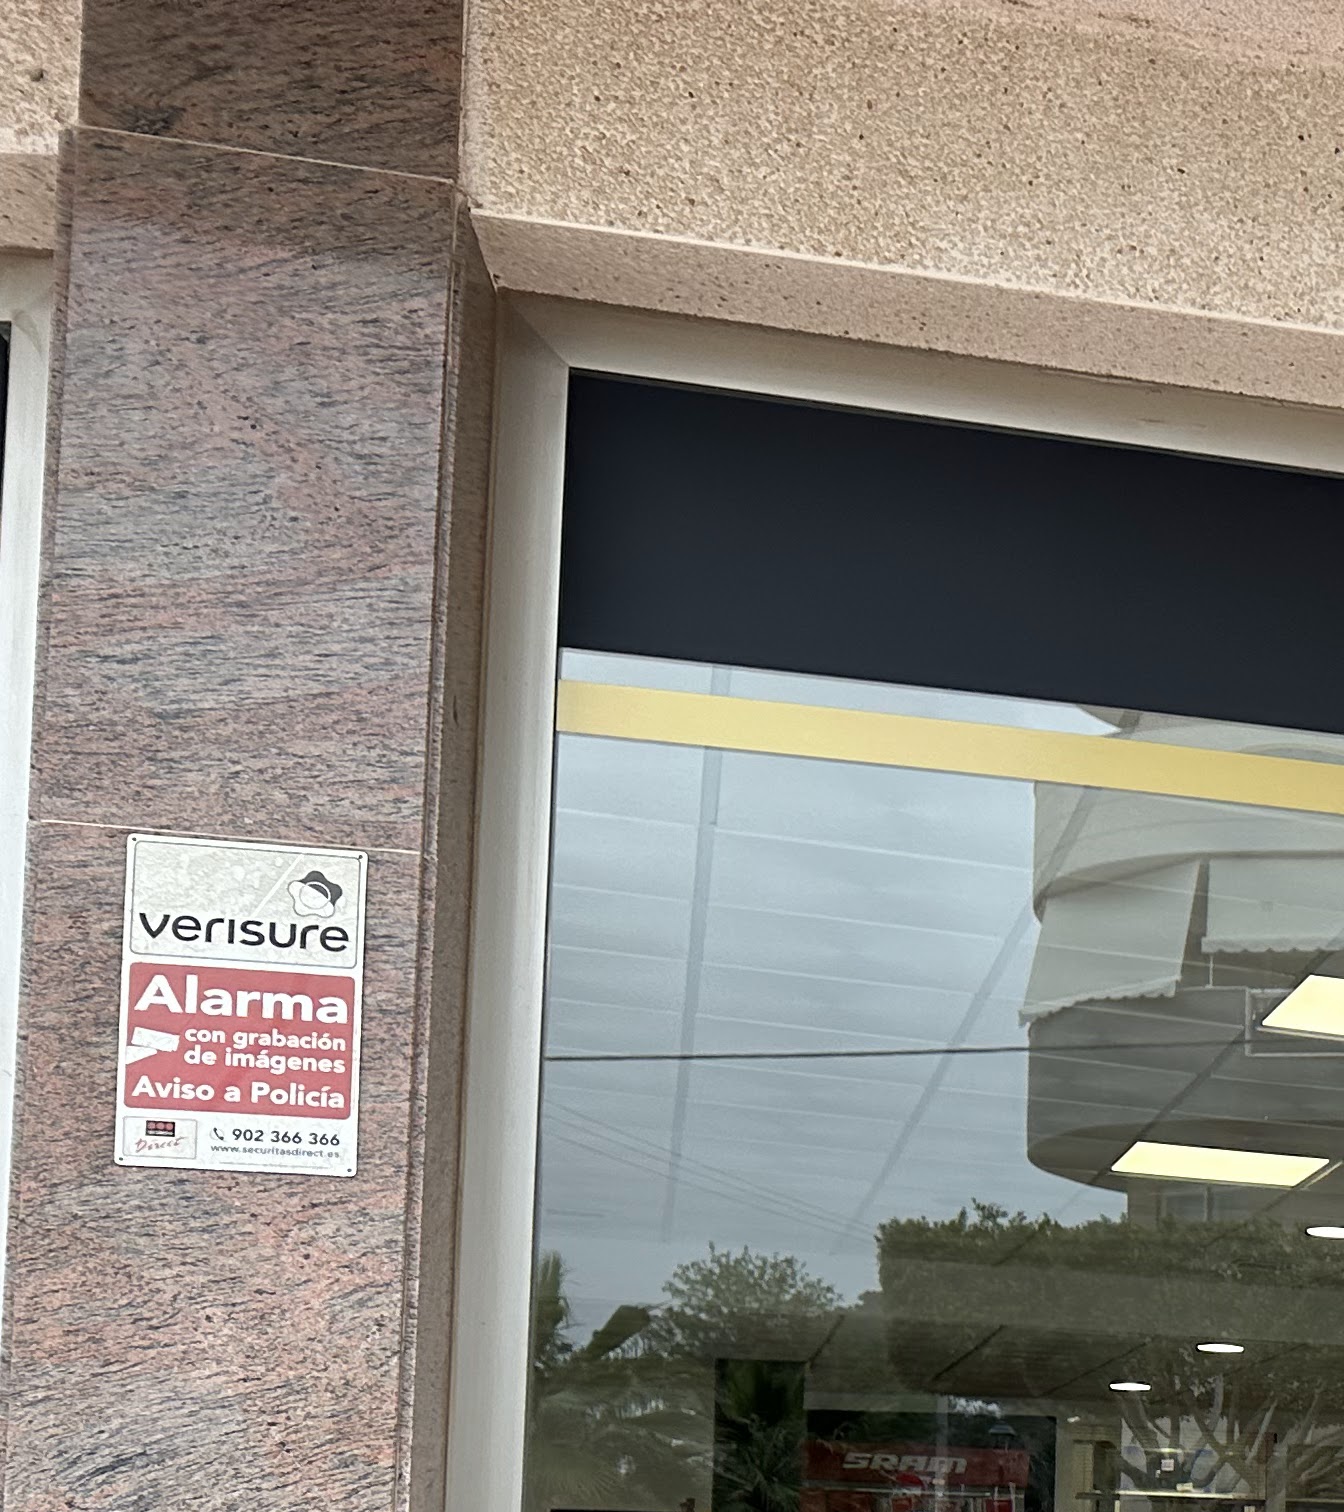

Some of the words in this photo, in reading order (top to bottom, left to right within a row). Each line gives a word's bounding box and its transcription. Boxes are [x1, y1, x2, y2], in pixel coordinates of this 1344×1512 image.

[138, 912, 349, 952] verisure
[133, 974, 349, 1025] Alarma
[184, 1028, 226, 1044] con
[233, 1029, 346, 1052] grabación
[183, 1046, 217, 1066] de
[225, 1049, 346, 1075] imágenes
[131, 1075, 215, 1100] Aviso
[223, 1086, 241, 1102] a
[251, 1081, 345, 1109] Policía
[232, 1128, 264, 1142] 902
[270, 1131, 302, 1144] 366
[308, 1132, 340, 1146] 366
[210, 1145, 340, 1158] www.securitasdirect.es
[843, 1453, 967, 1474] SRAM
